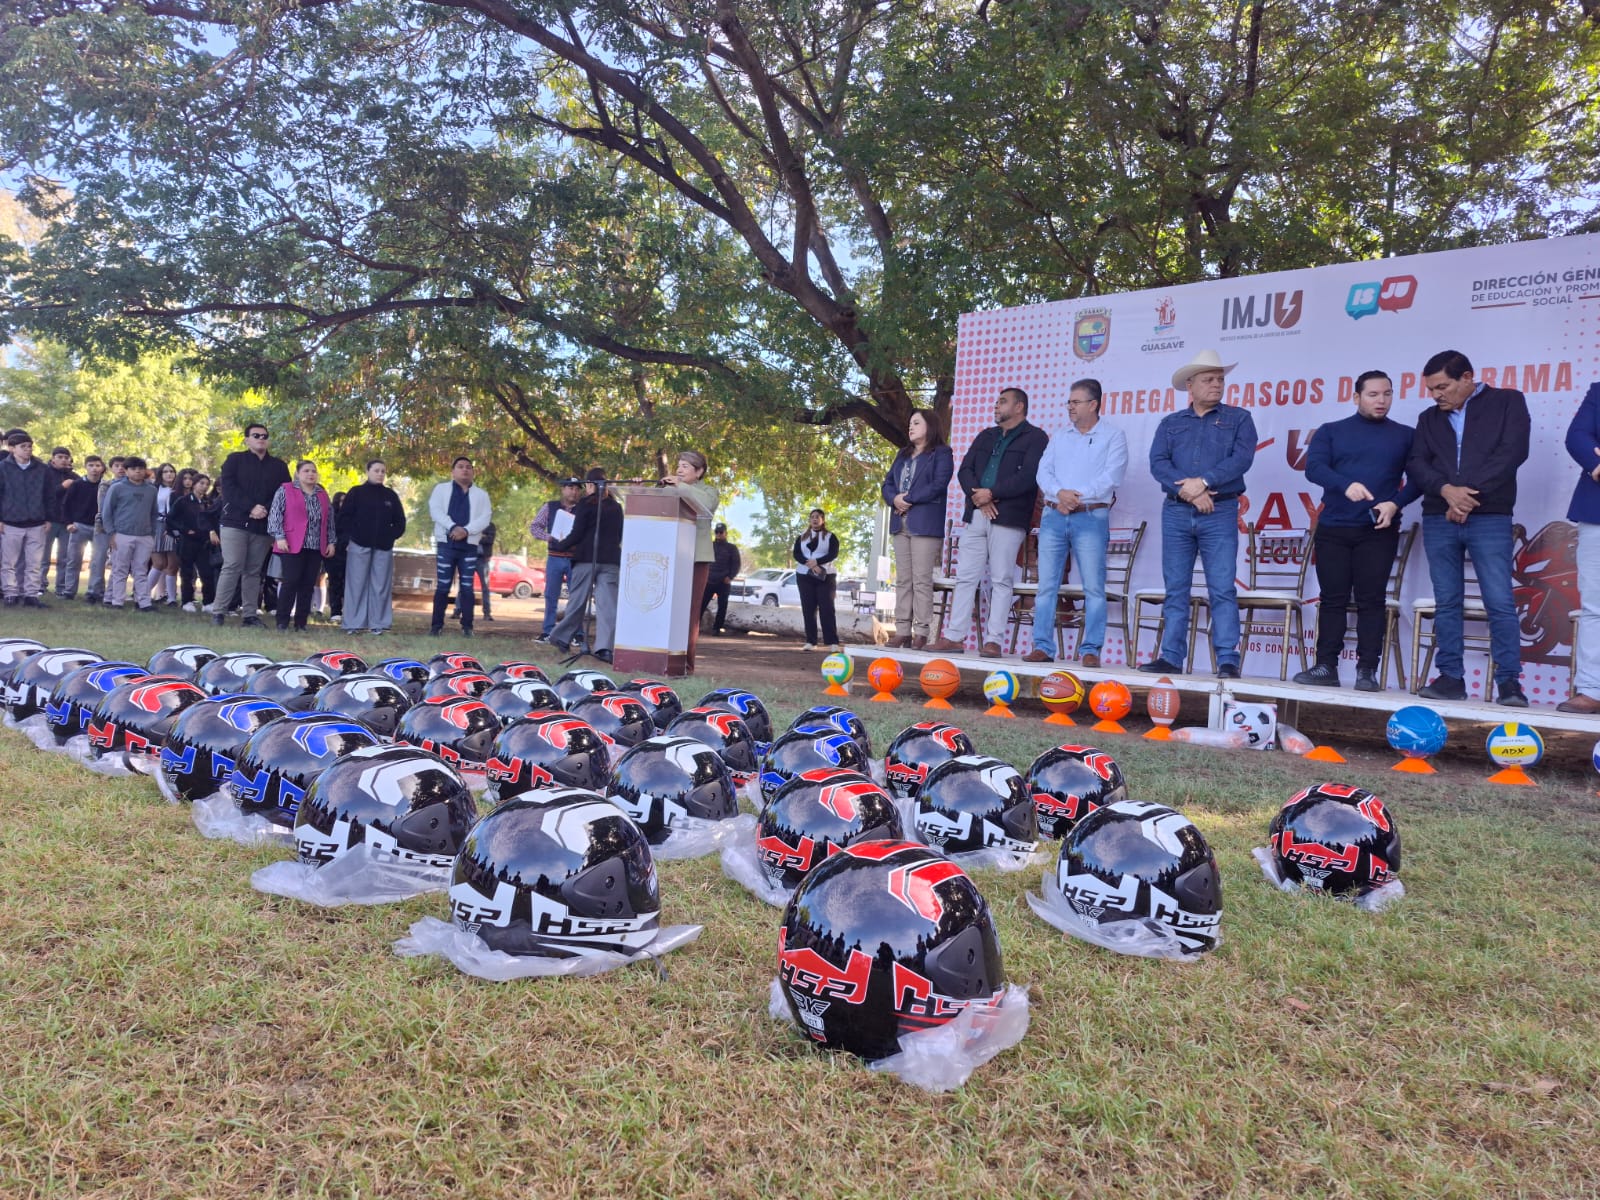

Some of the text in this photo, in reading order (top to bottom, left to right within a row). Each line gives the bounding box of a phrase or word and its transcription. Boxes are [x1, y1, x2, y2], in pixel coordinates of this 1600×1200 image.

[1472, 271, 1558, 292] DIRECCIÓN
[1471, 293, 1486, 303] DE
[1487, 285, 1552, 301] EDUCACIÓN
[1555, 286, 1563, 295] Y
[1532, 294, 1573, 306] SOCIAL
[1140, 340, 1185, 352] GUASAVE
[1400, 362, 1574, 400] PRRAMA
[1226, 377, 1325, 407] CASCOS
[1501, 747, 1525, 755] ADX
